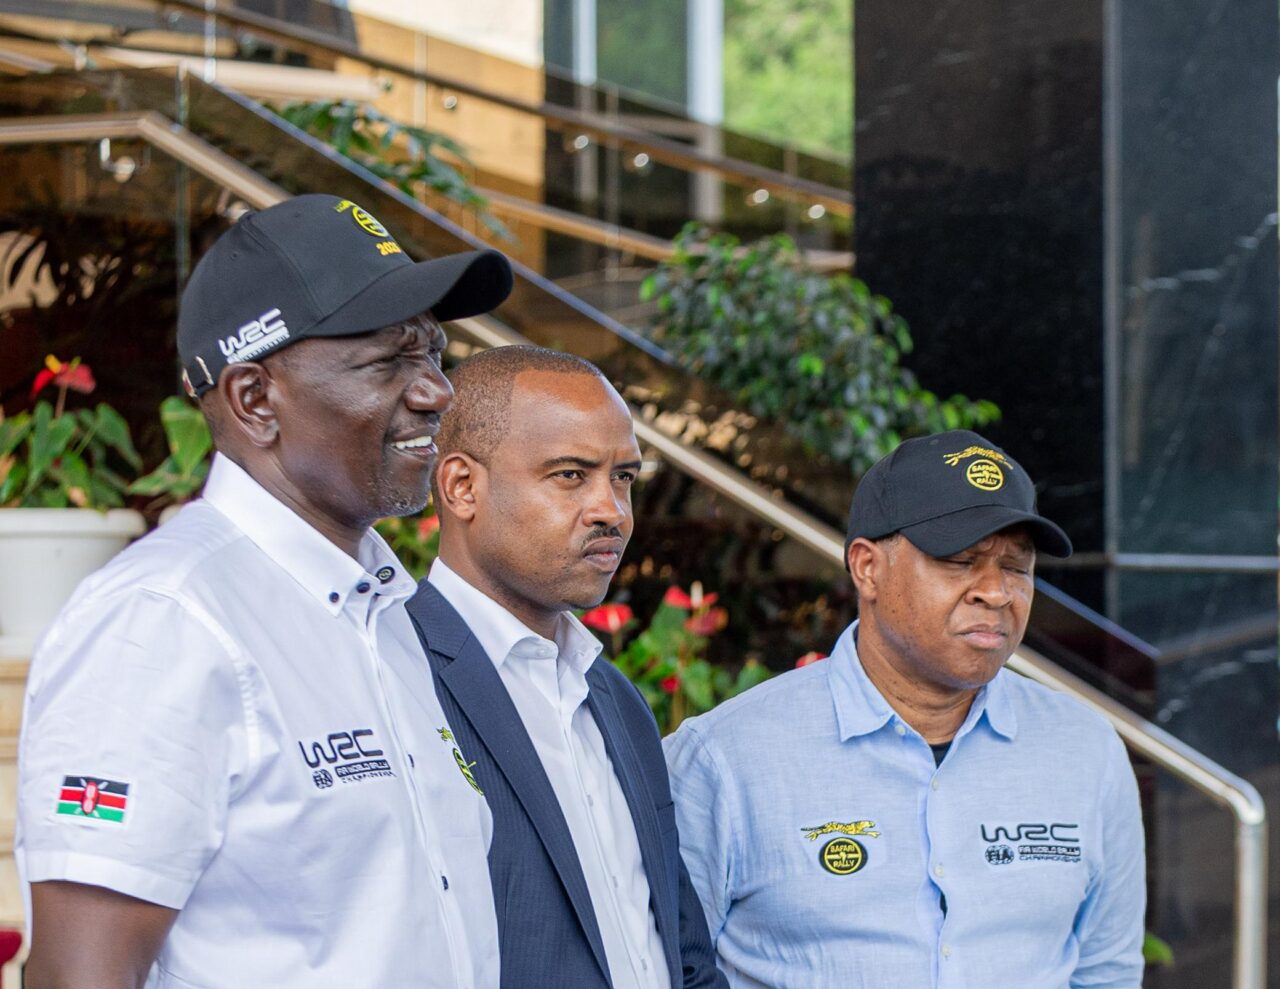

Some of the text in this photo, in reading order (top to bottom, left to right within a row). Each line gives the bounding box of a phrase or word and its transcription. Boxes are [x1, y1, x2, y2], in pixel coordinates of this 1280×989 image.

[218, 308, 286, 357] WRC
[298, 729, 383, 768] WRC
[981, 823, 1080, 843] WRC
[830, 844, 856, 853] SAFARI
[833, 859, 855, 868] RALLY
